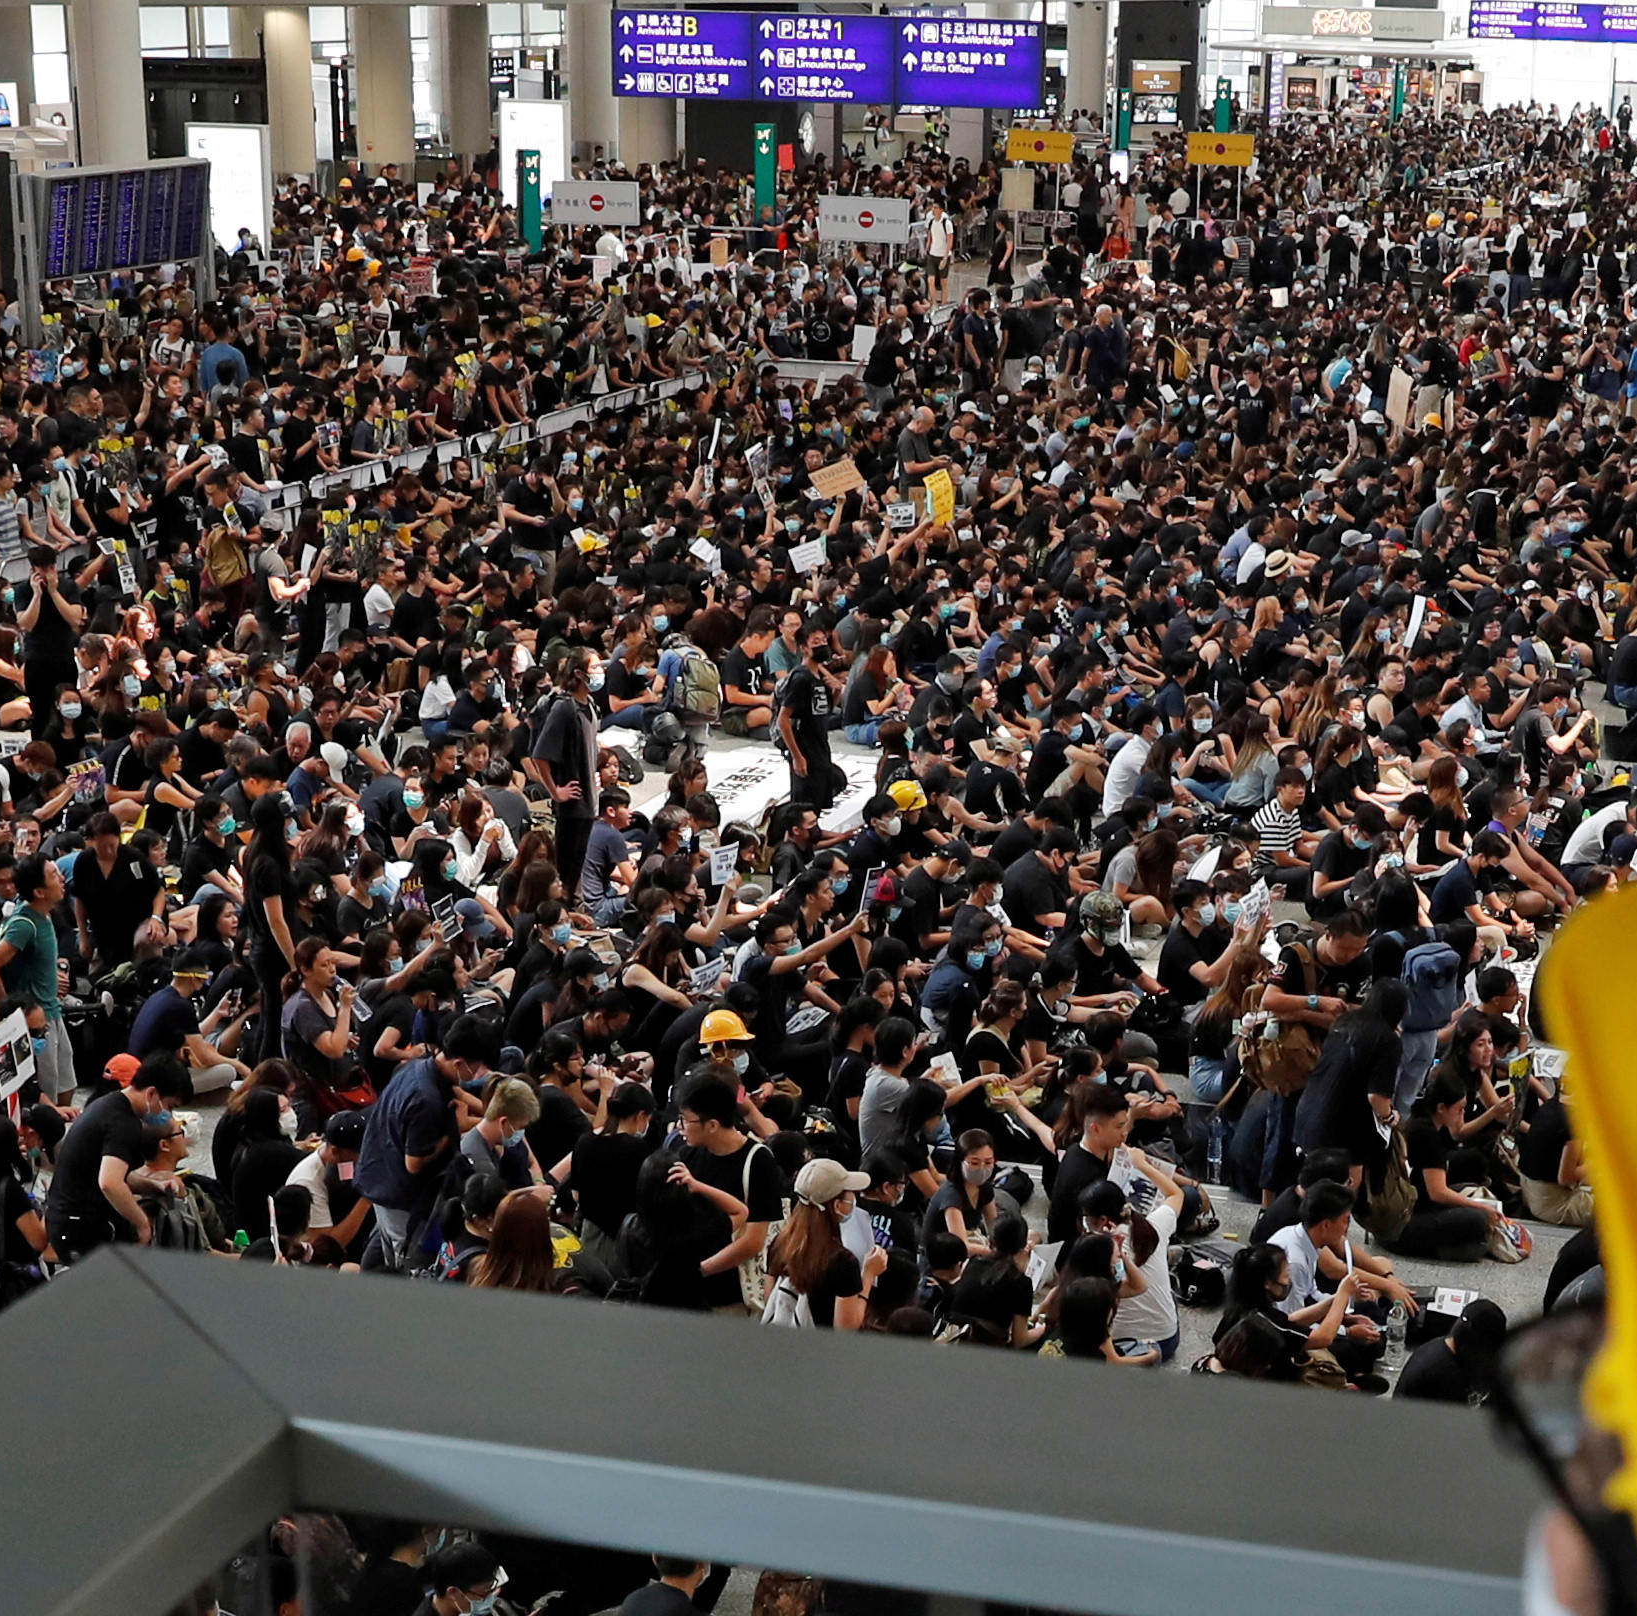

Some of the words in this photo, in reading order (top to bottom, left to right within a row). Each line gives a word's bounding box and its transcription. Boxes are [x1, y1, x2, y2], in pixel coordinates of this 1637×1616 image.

[637, 27, 665, 36] Arrivals
[666, 27, 682, 36] Hall
[684, 16, 698, 36] B
[834, 21, 844, 40] 1
[796, 30, 810, 40] Car
[812, 31, 829, 40] Park
[941, 34, 951, 43] To
[655, 56, 675, 66] Light
[676, 56, 701, 66] Goods
[701, 57, 728, 66] Vehicle
[729, 58, 747, 67] Area
[796, 60, 836, 70] Limousine
[837, 61, 866, 71] Lounge
[921, 64, 946, 73] Airline
[948, 64, 975, 74] Offices
[694, 85, 719, 94] Toilets
[796, 88, 827, 97] Medical
[828, 89, 854, 99] Centre
[872, 1214, 892, 1236] ELL
